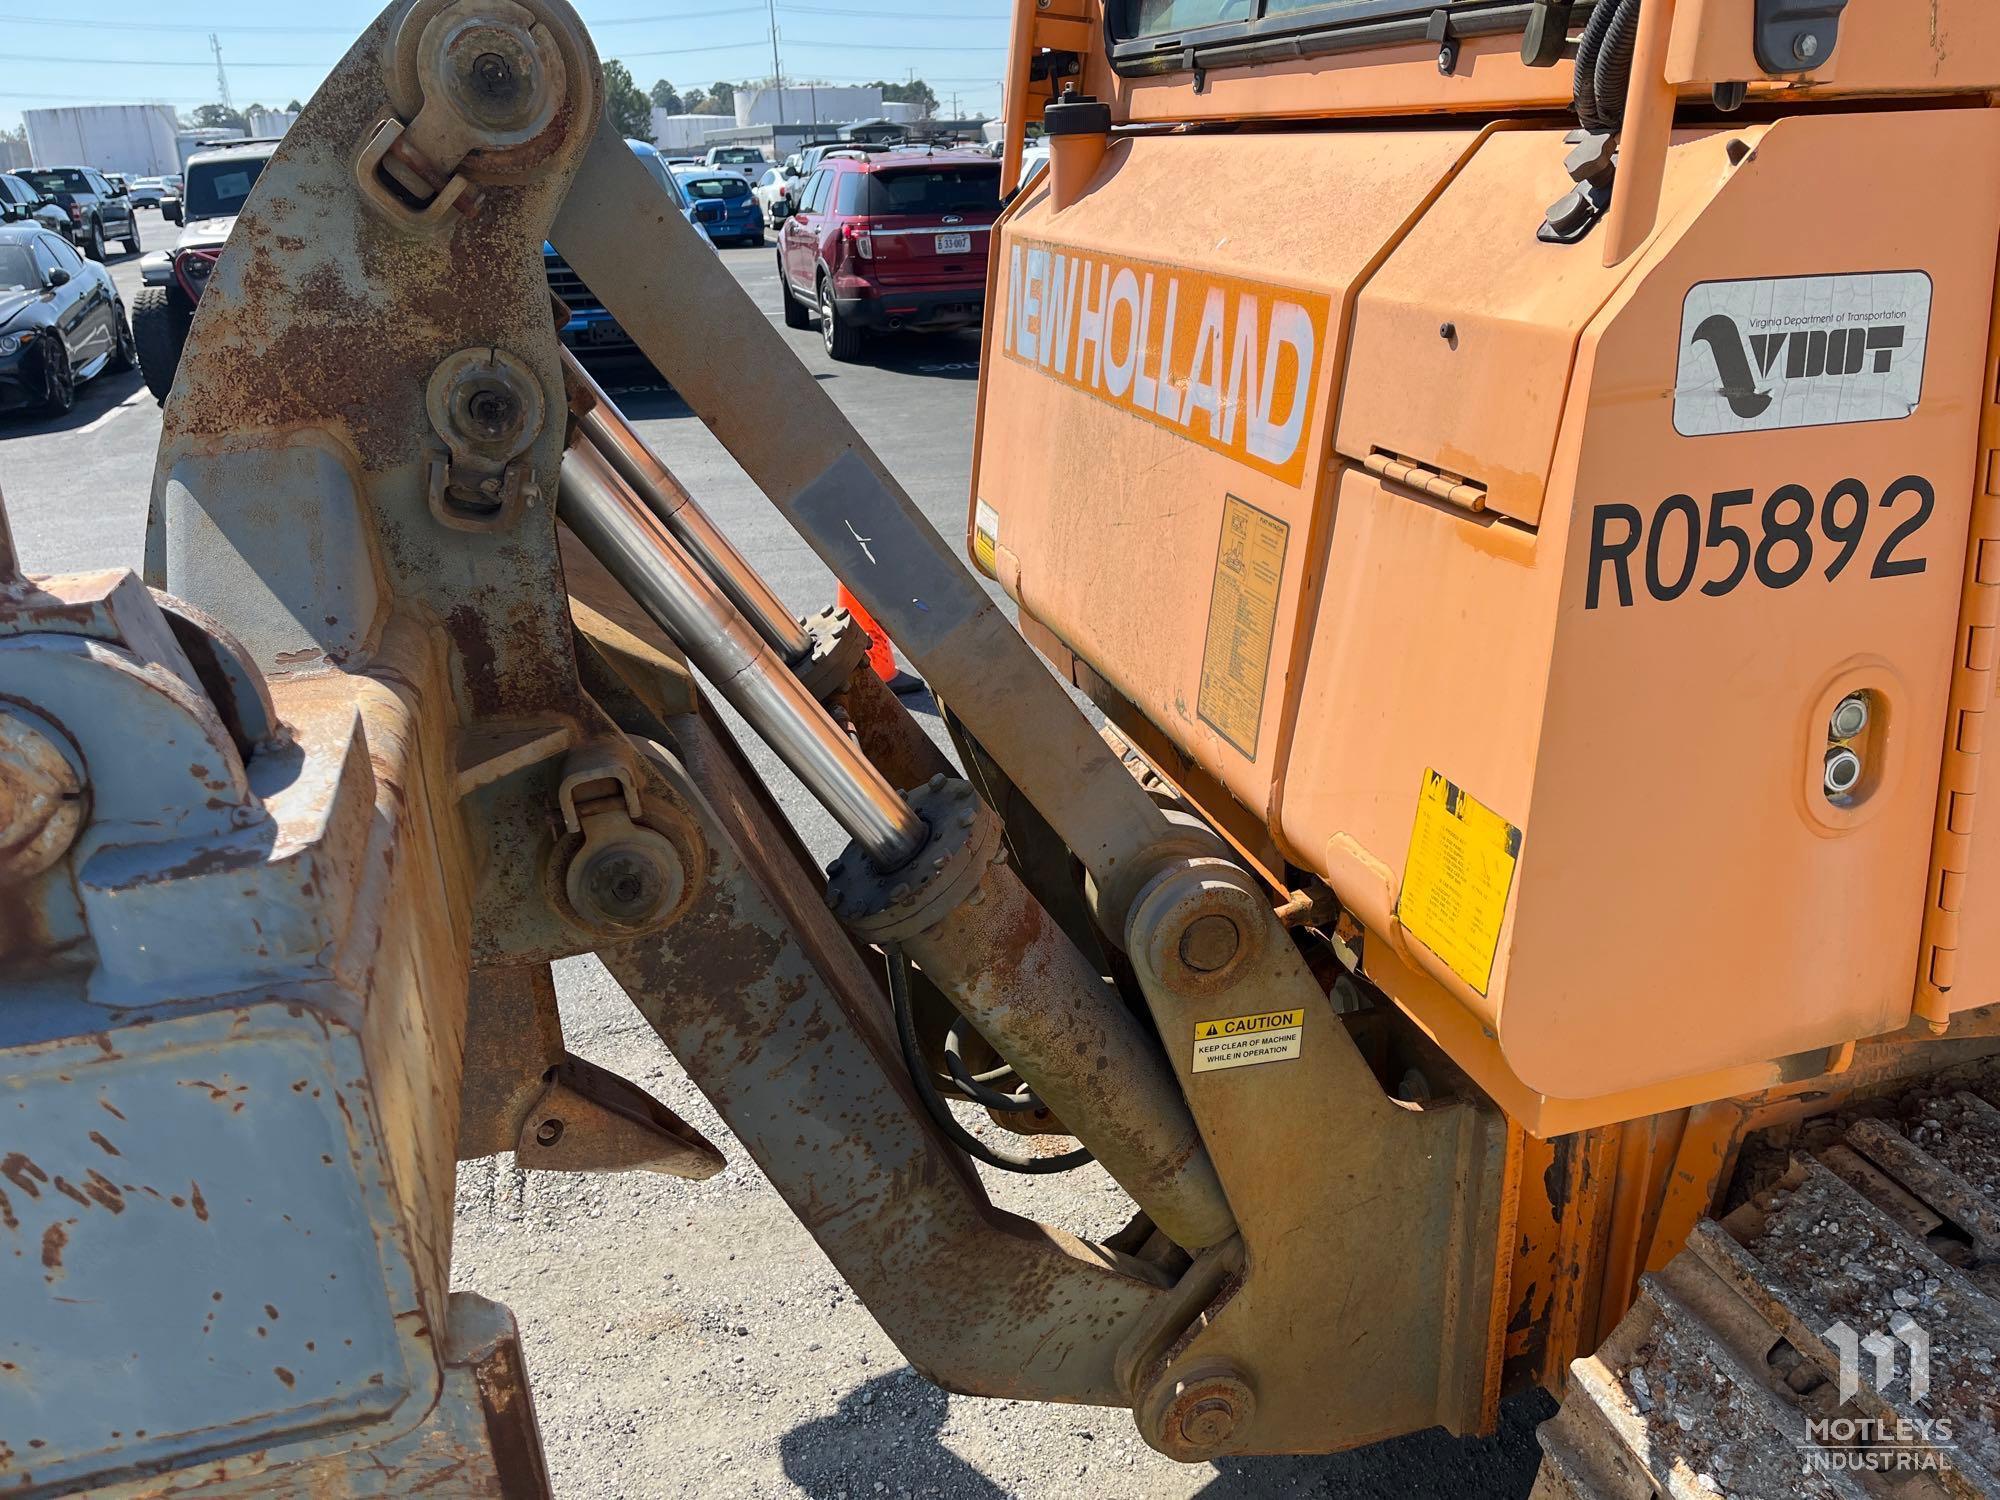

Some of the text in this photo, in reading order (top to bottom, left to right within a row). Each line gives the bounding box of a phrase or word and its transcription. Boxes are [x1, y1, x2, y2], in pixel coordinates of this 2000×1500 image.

[1749, 309, 1907, 328] Virginia Department of Transportation
[1004, 244, 1315, 465] NEW HOLLAND
[1748, 325, 1905, 379] VDOT
[1585, 474, 1935, 610] R05892
[1224, 1013, 1293, 1034] CAUTION
[1198, 1033, 1297, 1054] KEEP CLEAR OF MACHINE
[1207, 1045, 1288, 1063] WHILE IN OPERATION
